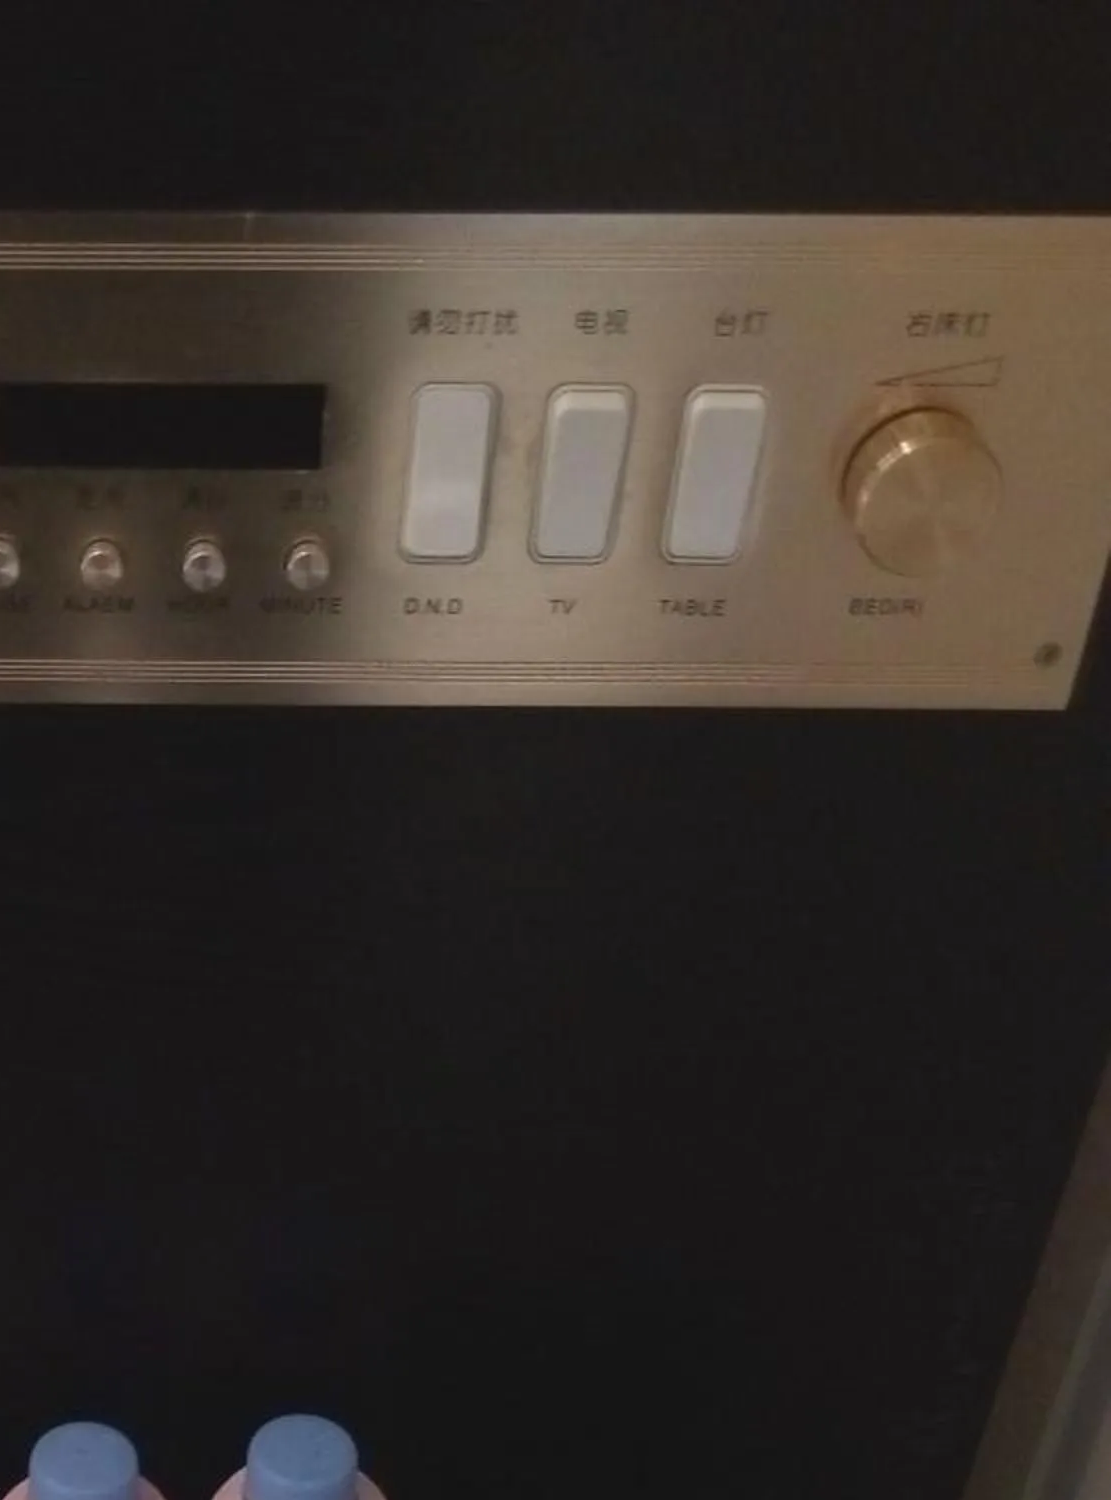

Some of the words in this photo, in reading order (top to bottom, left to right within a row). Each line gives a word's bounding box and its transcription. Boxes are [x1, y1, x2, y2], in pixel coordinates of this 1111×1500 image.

[575, 309, 629, 336] 电视
[714, 311, 770, 337] 台灯
[549, 599, 578, 615] TV
[660, 600, 727, 617] TABLE
